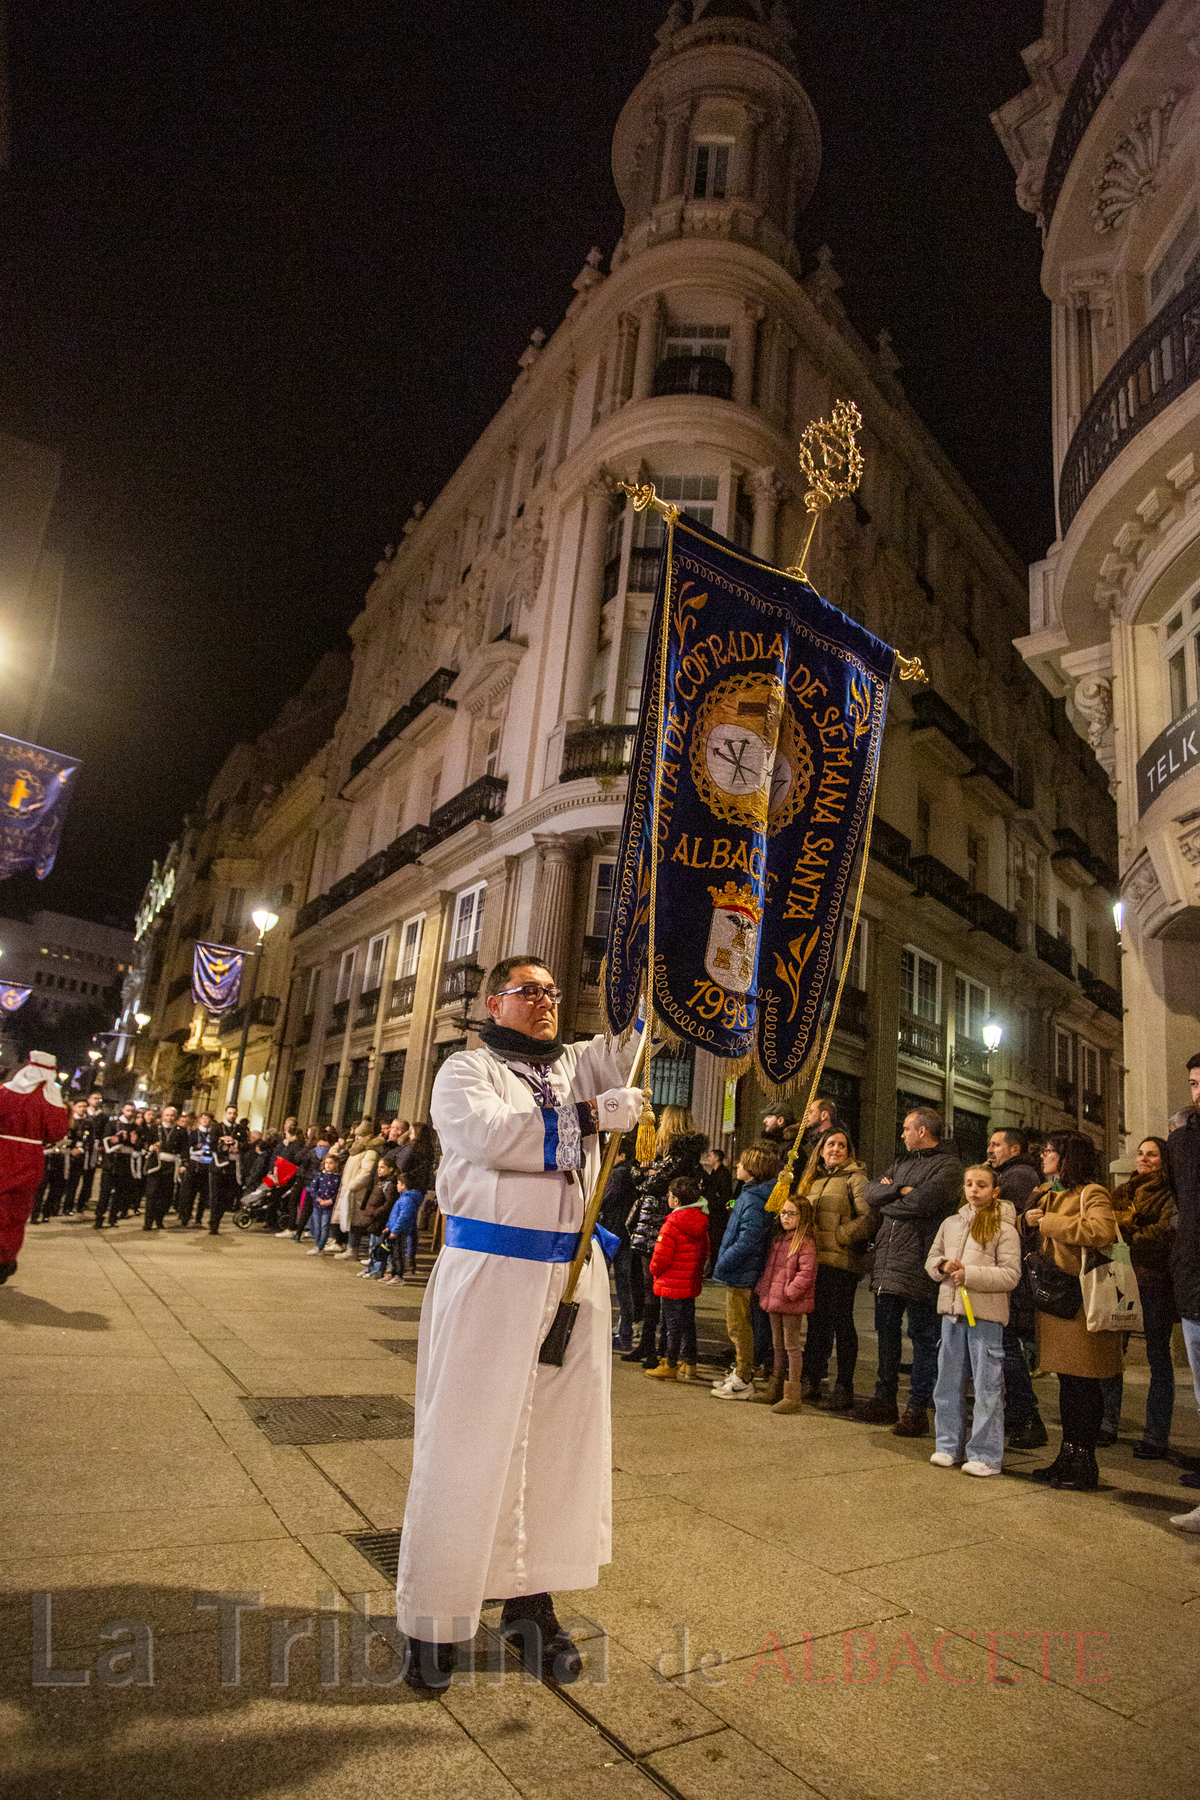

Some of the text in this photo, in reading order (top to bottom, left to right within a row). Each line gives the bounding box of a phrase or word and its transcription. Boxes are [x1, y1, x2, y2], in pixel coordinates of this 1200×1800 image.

[675, 631, 791, 700] COFRADIA
[788, 663, 828, 709] DE
[664, 702, 690, 755] DE
[810, 706, 853, 825] SEMANA
[1147, 730, 1198, 792] TELK
[782, 831, 834, 920] SANTA
[686, 980, 748, 1029] 1998
